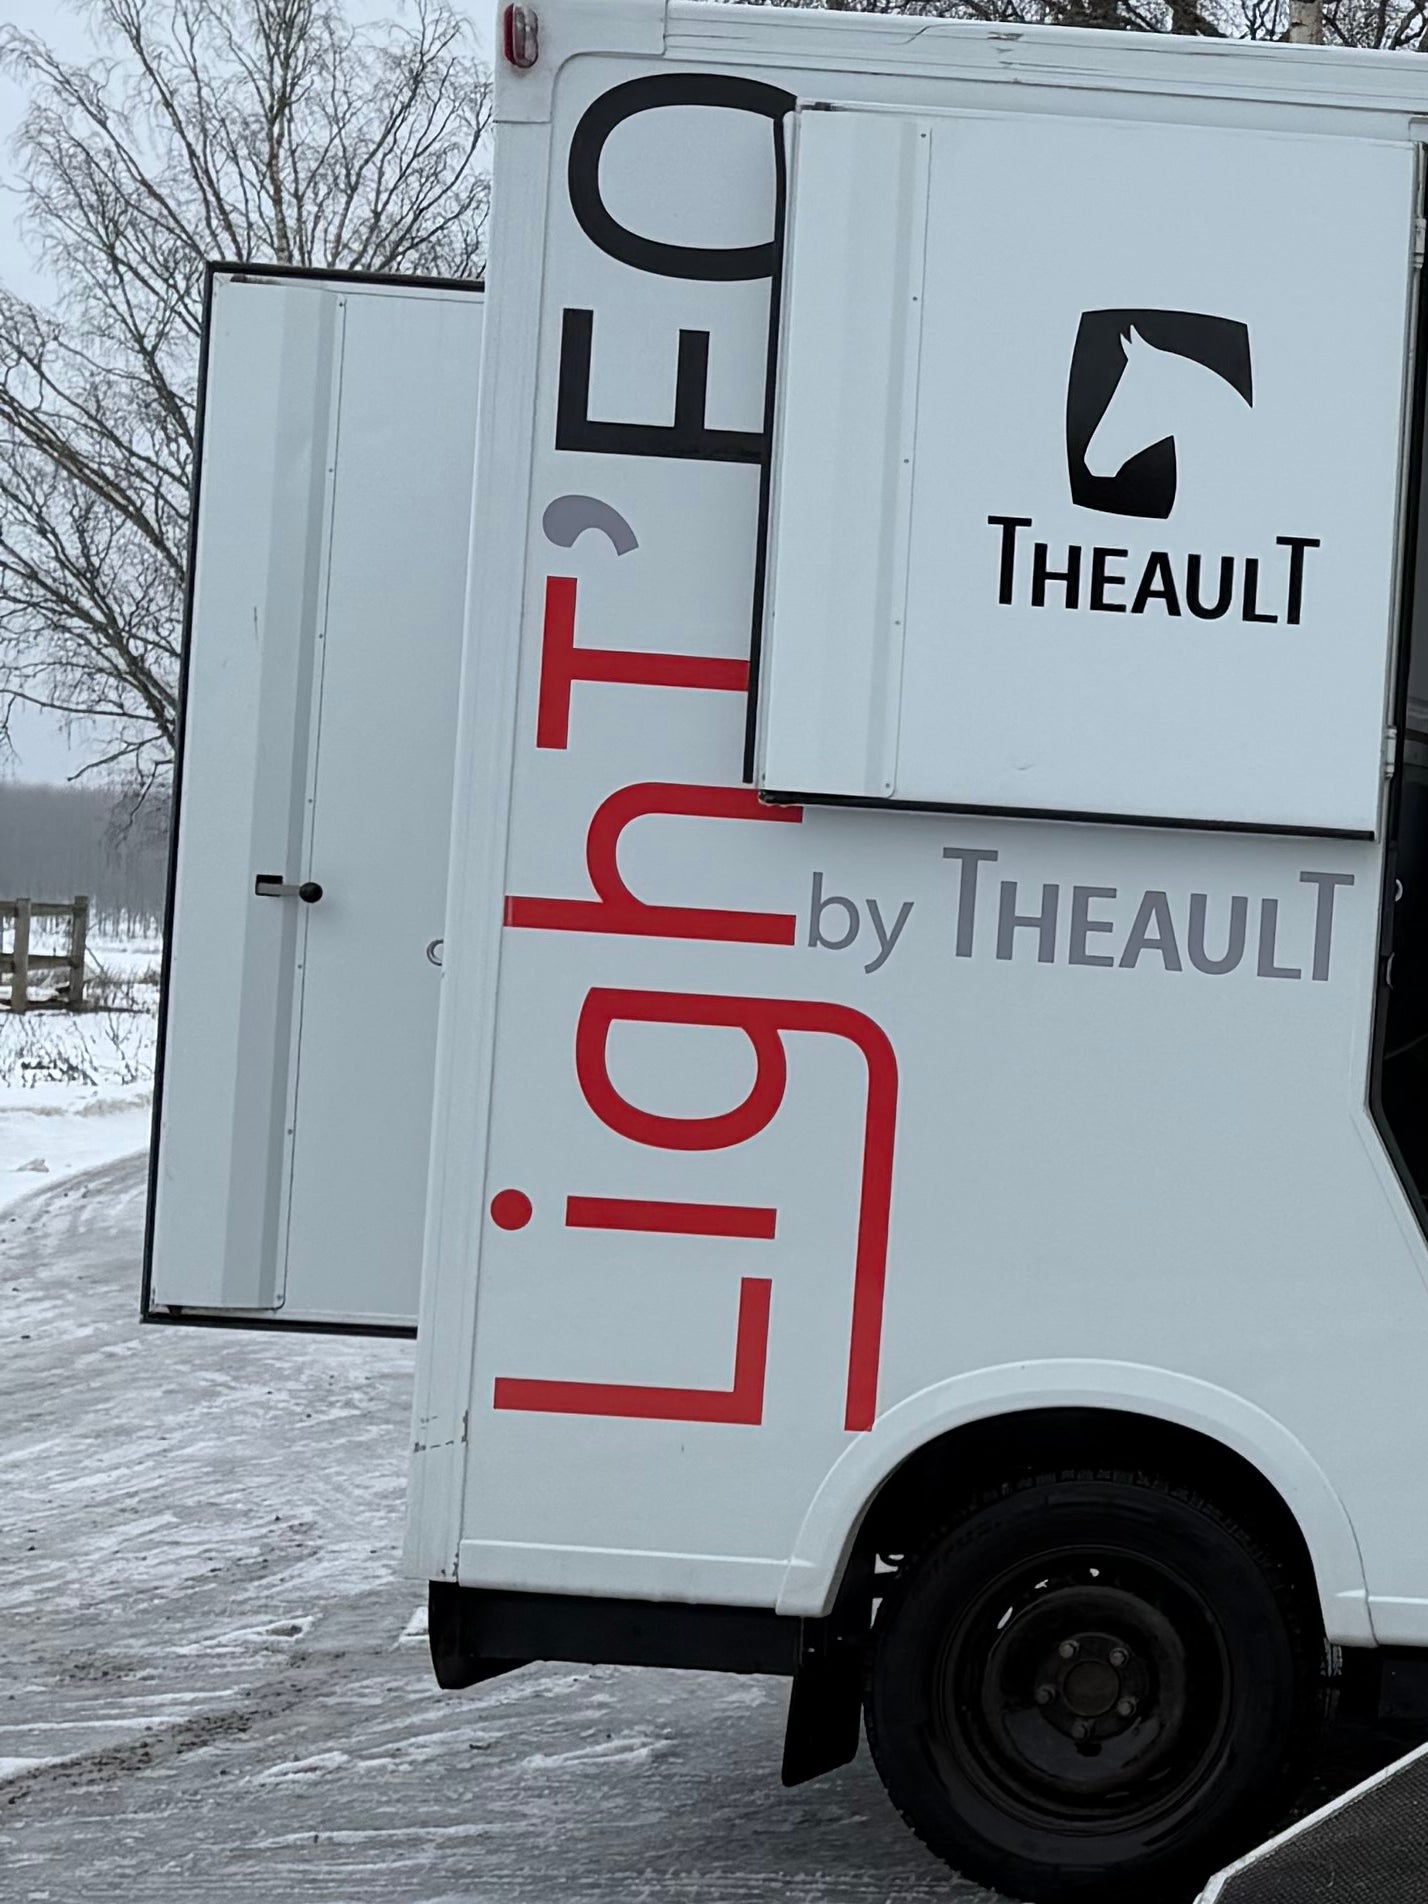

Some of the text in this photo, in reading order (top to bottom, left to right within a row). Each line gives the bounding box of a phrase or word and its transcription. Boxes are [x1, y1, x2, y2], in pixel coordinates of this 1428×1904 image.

[987, 514, 1321, 625] THEAULT
[808, 847, 1355, 982] by THEAULT
